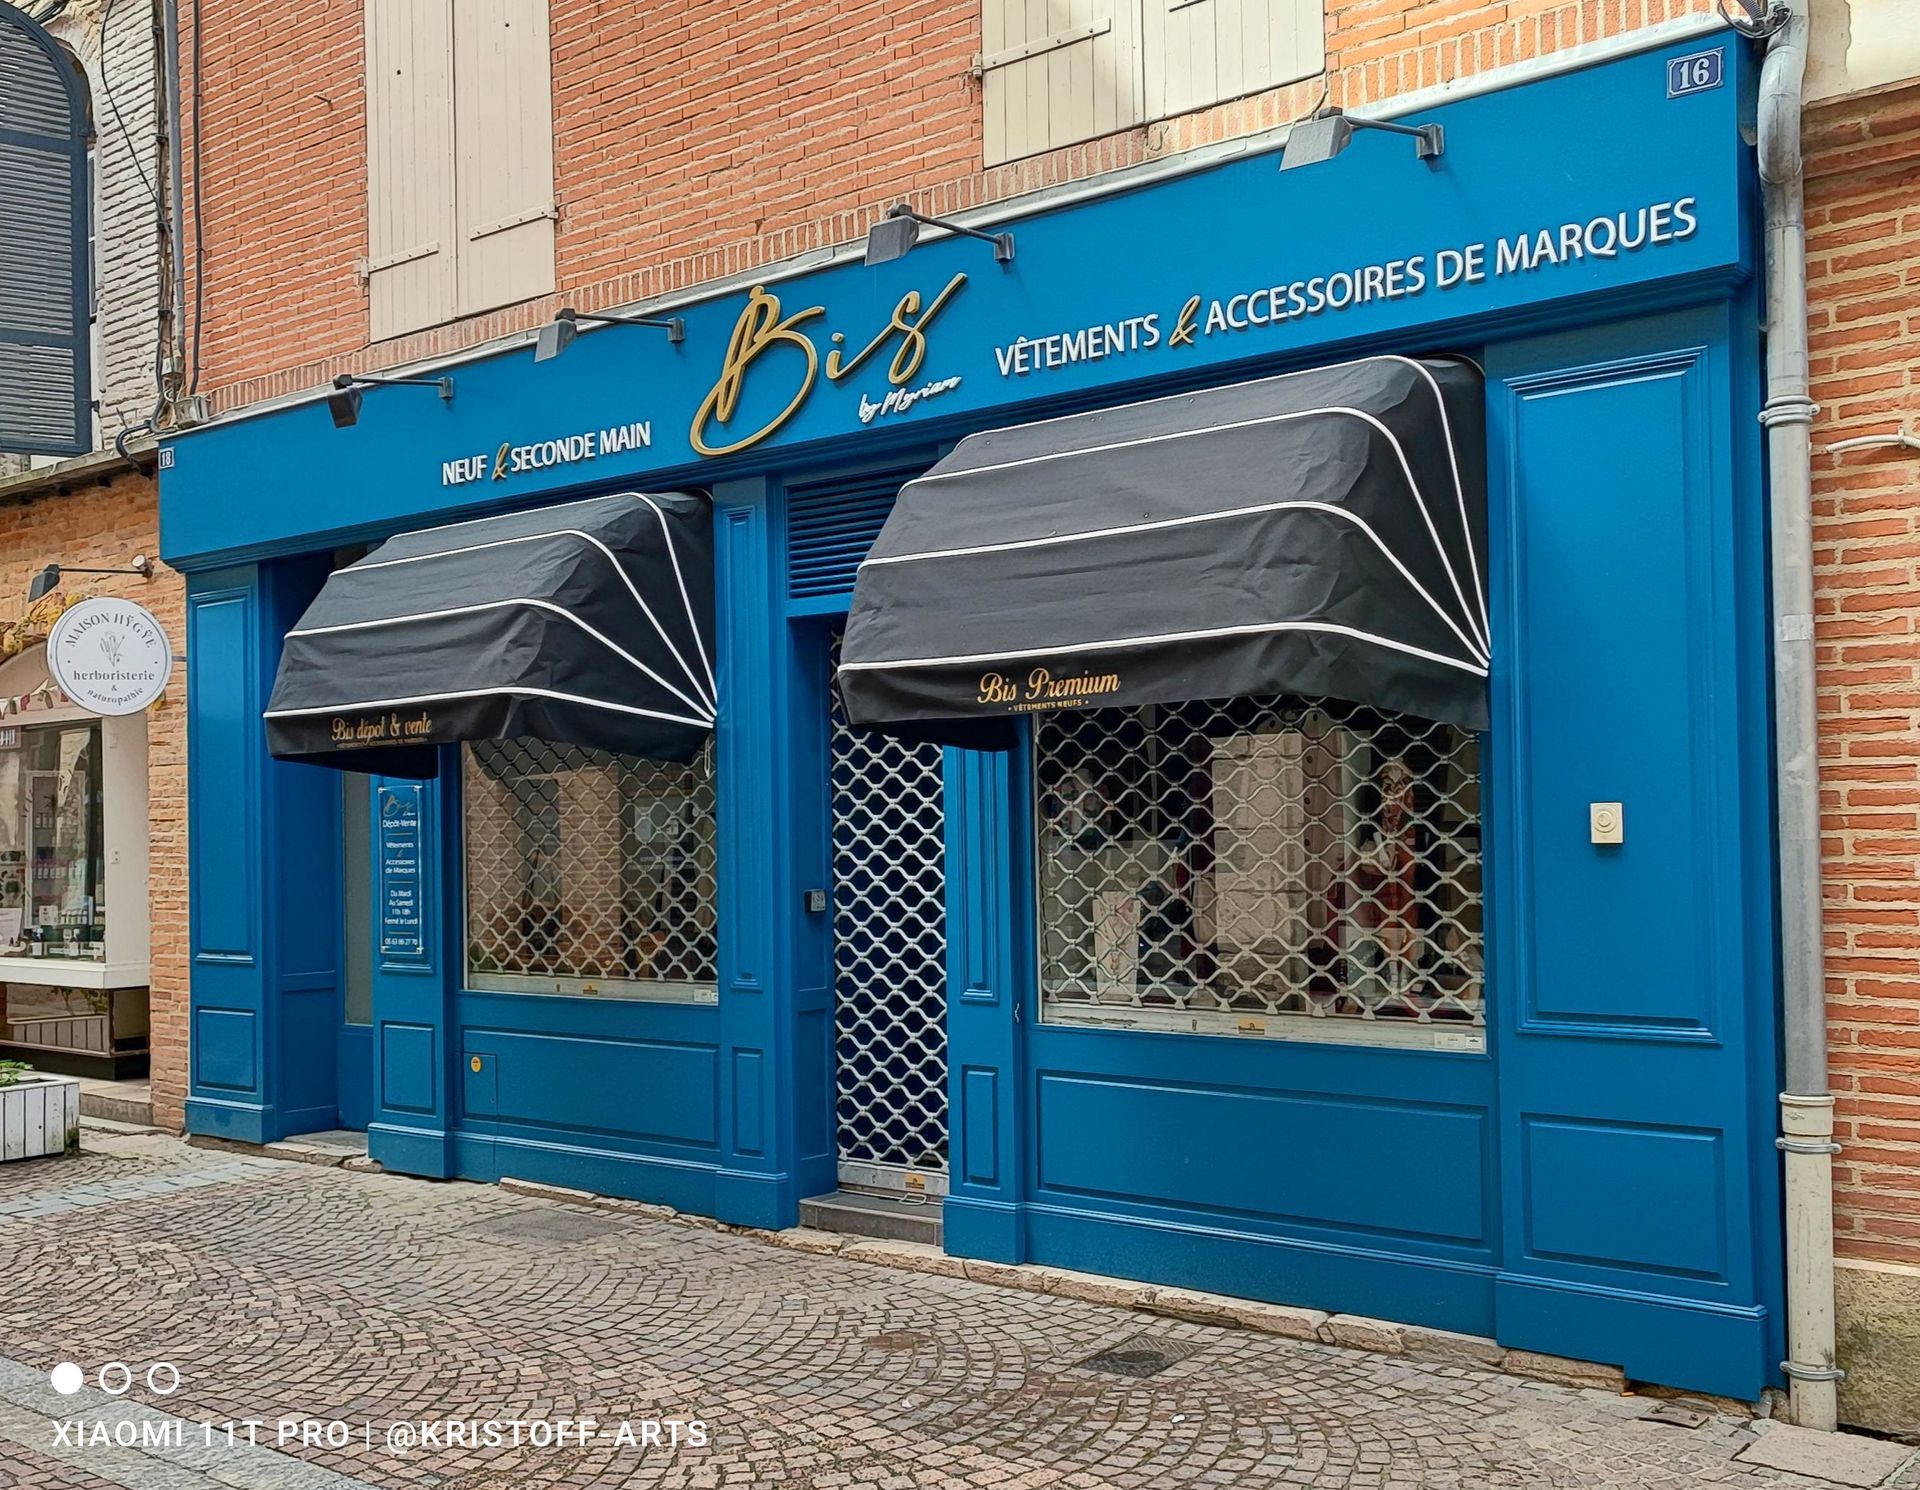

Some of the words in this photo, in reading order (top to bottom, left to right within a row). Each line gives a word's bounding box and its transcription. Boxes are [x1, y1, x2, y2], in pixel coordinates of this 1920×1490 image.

[1680, 58, 1709, 89] 16
[995, 313, 1160, 376] VÊTEMENTS
[1169, 295, 1200, 346] &
[1205, 256, 1426, 335] ACCESSOIRES
[1436, 244, 1486, 288] DE
[1496, 197, 1697, 275] MARQUES
[689, 273, 968, 456] Bis
[858, 393, 882, 423] by
[880, 376, 962, 415] Myriam
[162, 451, 171, 467] 18
[442, 454, 487, 485] NEUF
[491, 442, 509, 480] &
[511, 432, 596, 473] SECONDE
[600, 421, 651, 455] MAIN
[65, 612, 109, 647] MAISON
[73, 669, 155, 681] herboristerie
[977, 672, 1017, 704] Bis
[1025, 667, 1121, 700] Premium
[87, 687, 144, 706] naturopathie
[1013, 701, 1056, 712] VÊTEMENTS
[1057, 699, 1082, 708] NEUFS
[332, 717, 355, 740] Bis
[390, 712, 401, 737] &
[405, 711, 433, 735] vente
